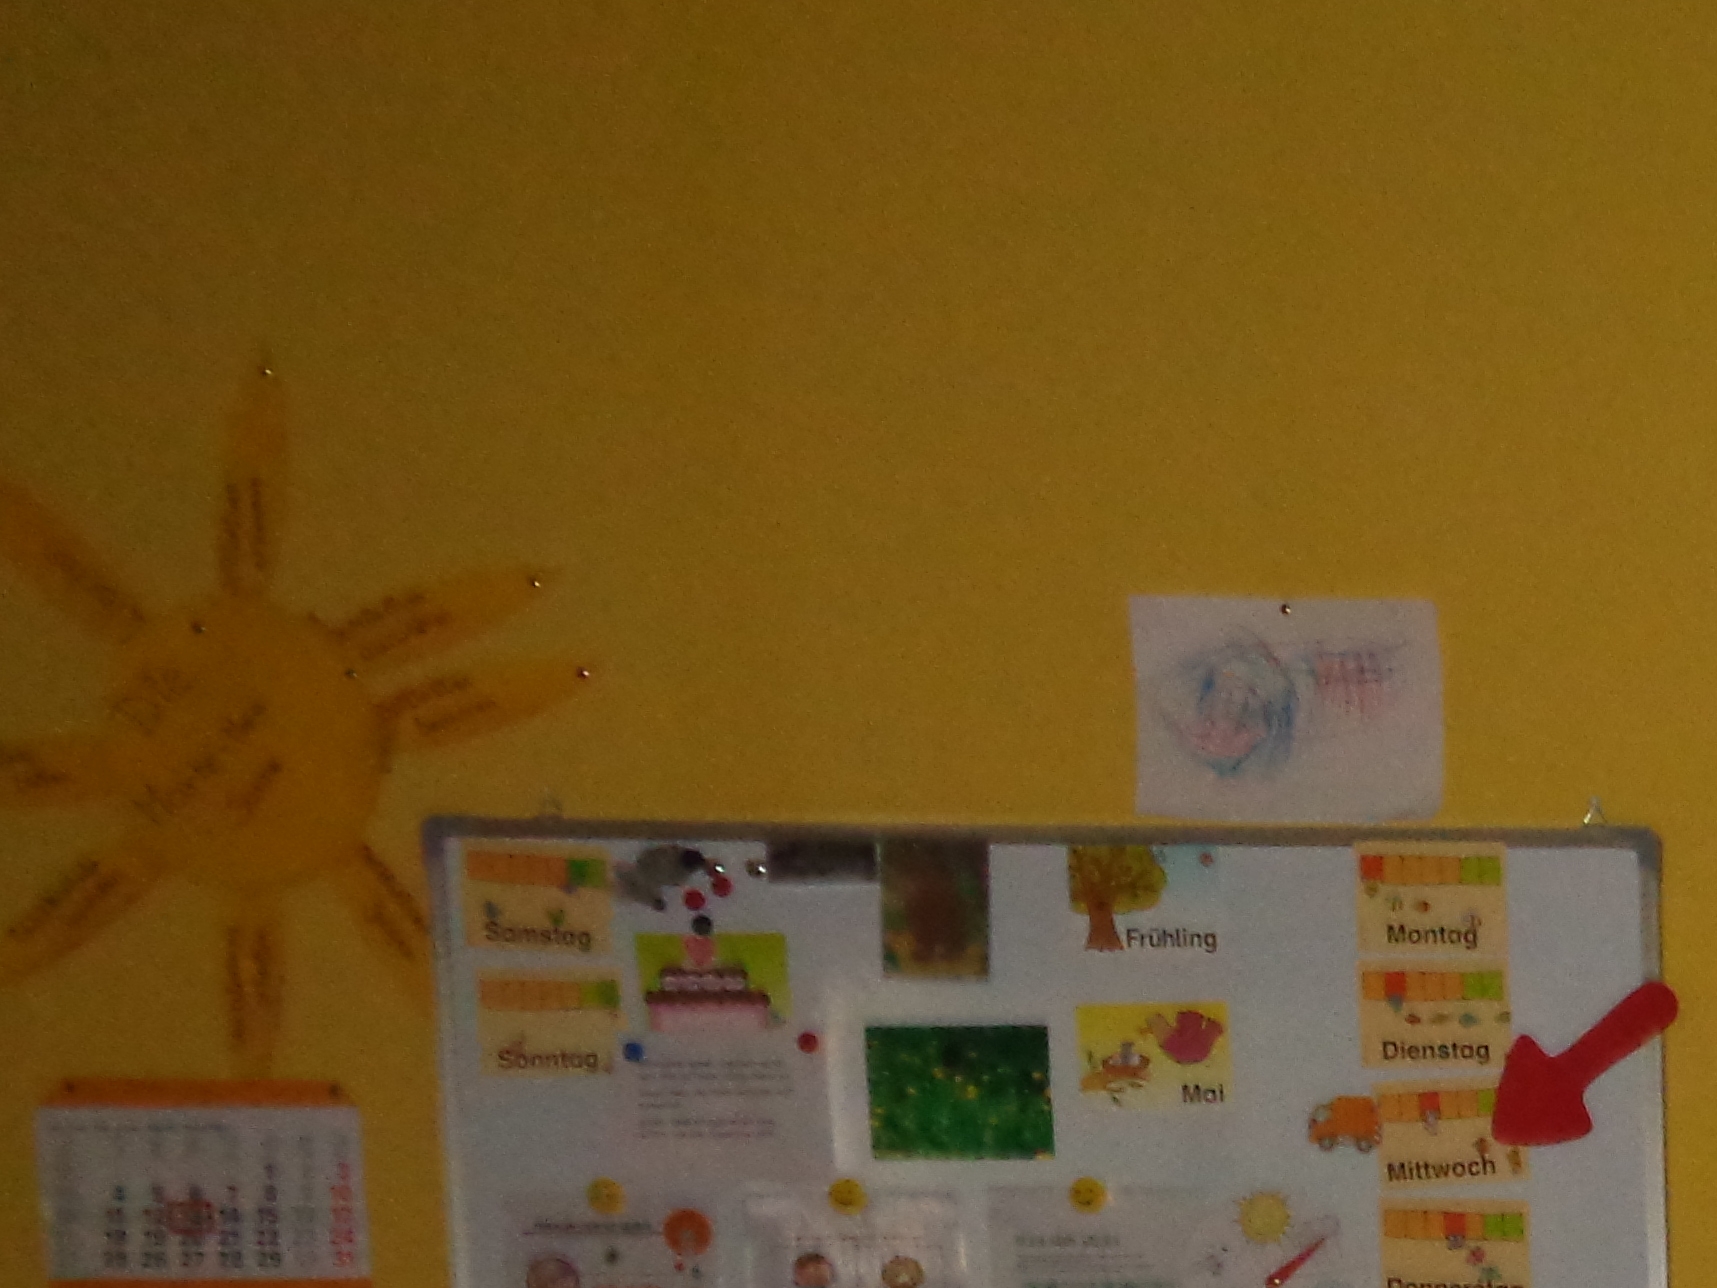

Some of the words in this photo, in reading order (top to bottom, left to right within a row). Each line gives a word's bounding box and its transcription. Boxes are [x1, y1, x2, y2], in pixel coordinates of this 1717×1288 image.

[484, 919, 592, 951] Samstag
[1126, 927, 1218, 953] Frühling
[1386, 924, 1480, 949] Montag
[497, 1049, 599, 1074] Sonntag
[1382, 1039, 1491, 1064] Dienstag
[1182, 1084, 1226, 1104] Mai
[1386, 1155, 1497, 1183] Mittwoch
